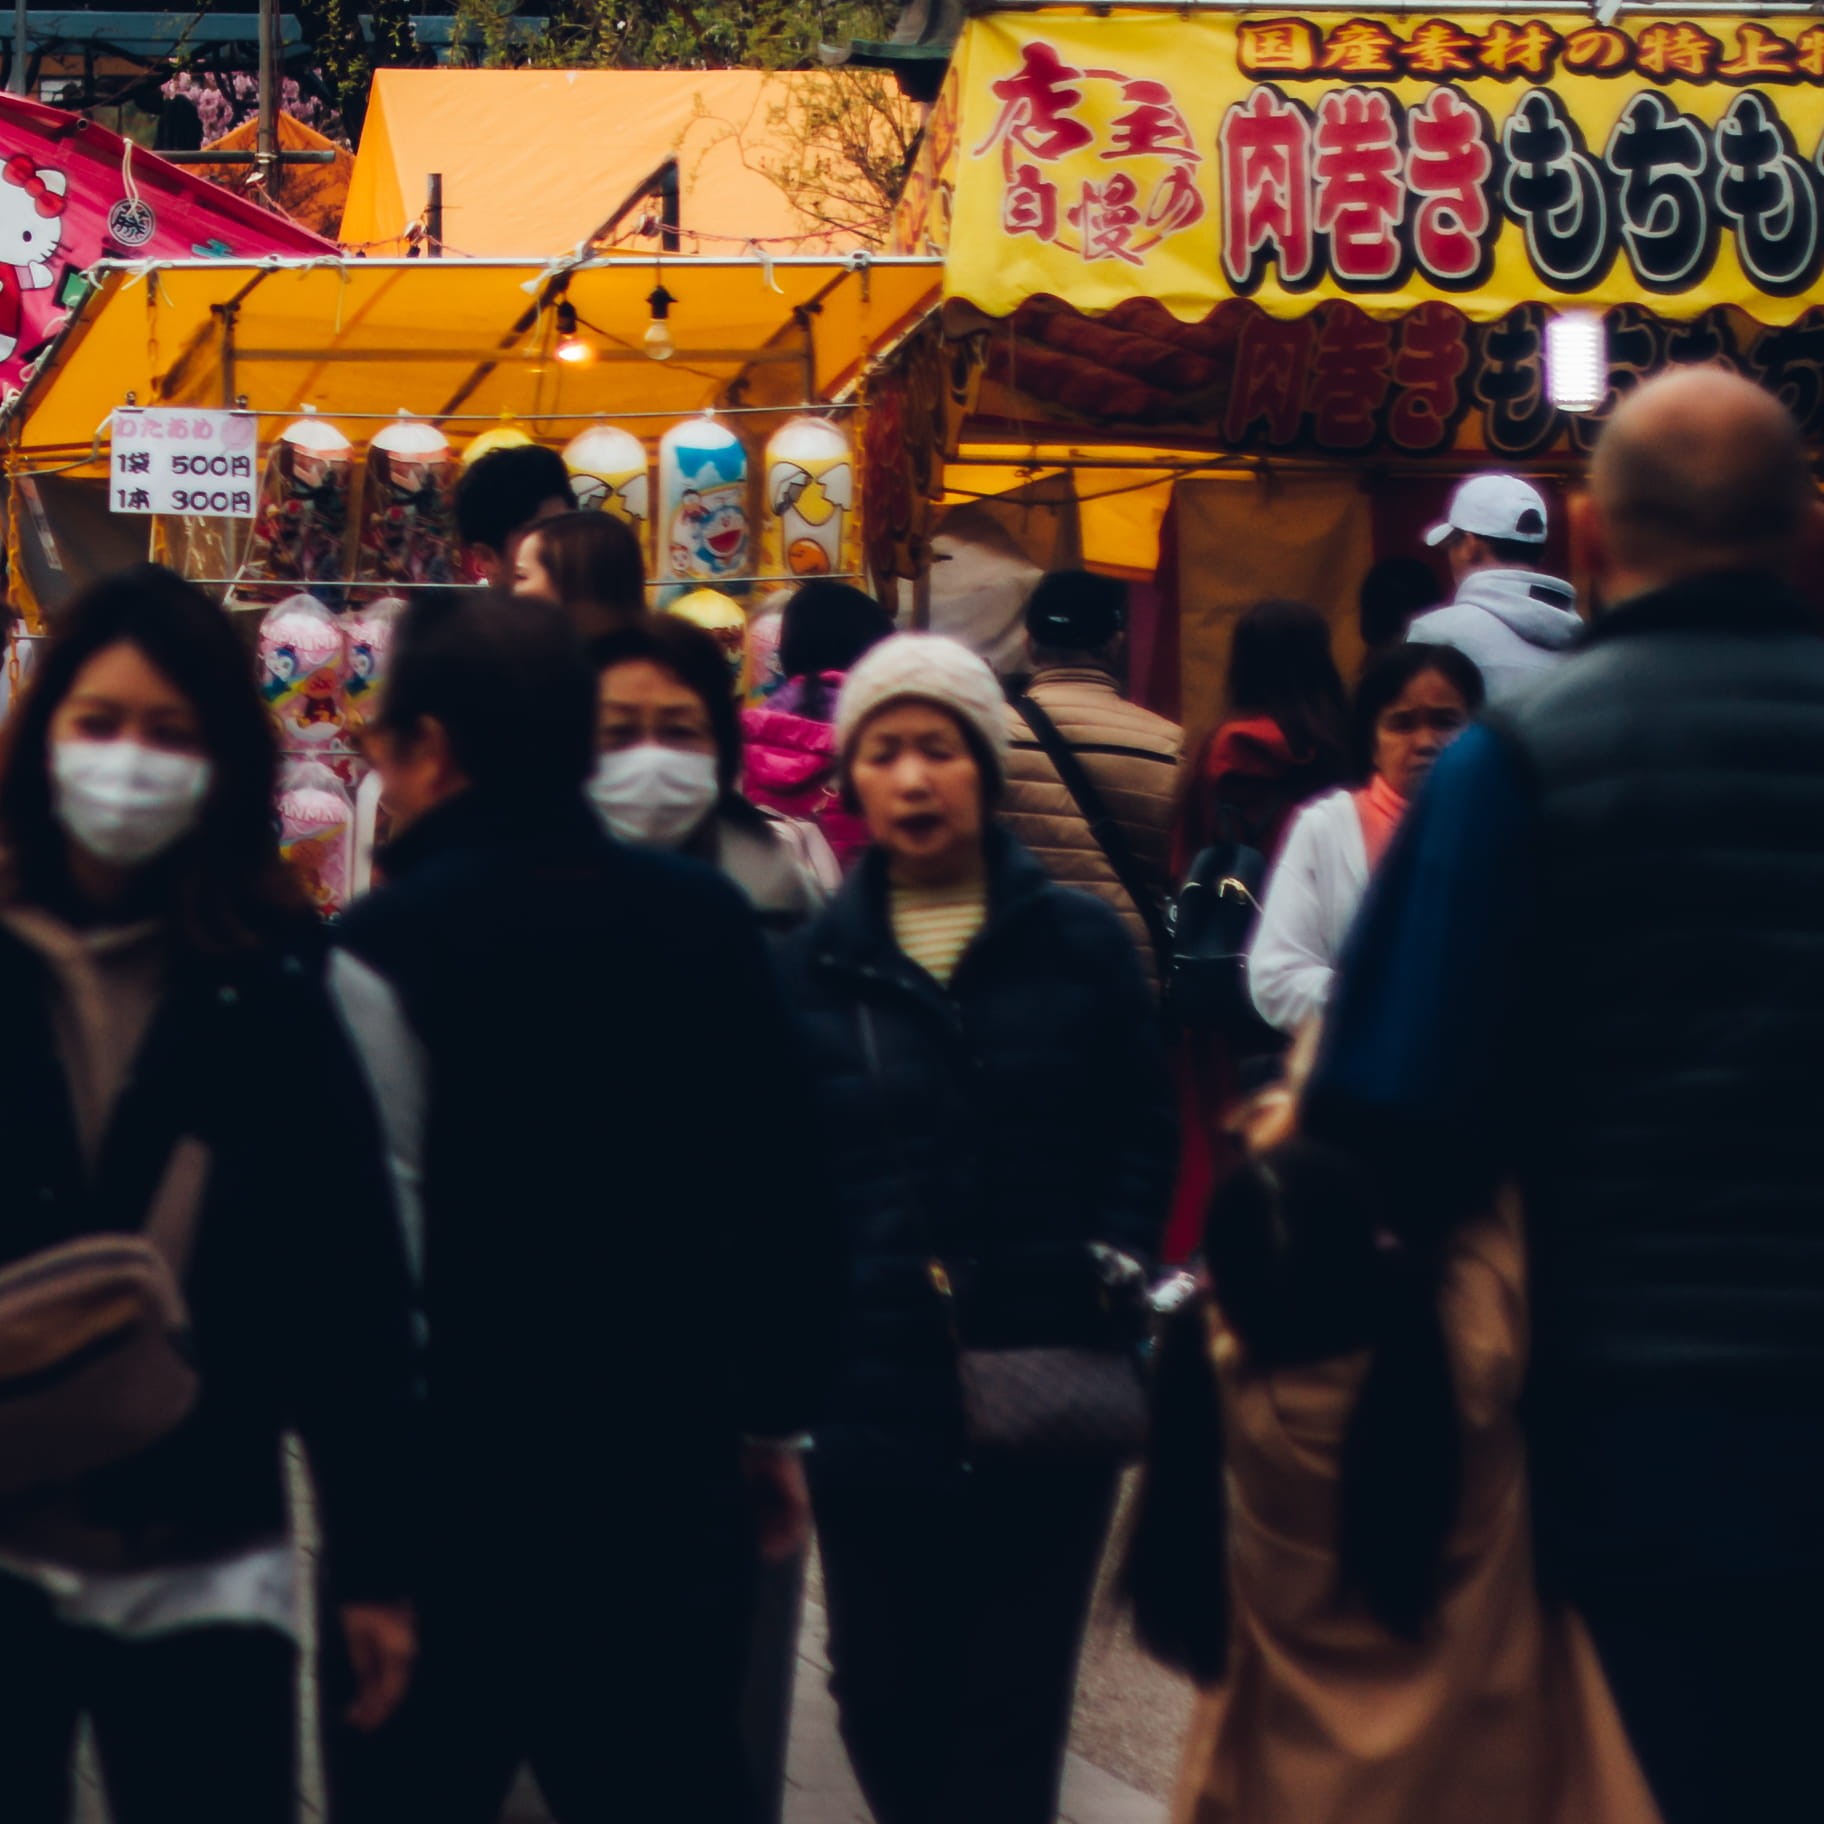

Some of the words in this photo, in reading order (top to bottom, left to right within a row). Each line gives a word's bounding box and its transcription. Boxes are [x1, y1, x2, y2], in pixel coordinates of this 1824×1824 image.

[972, 41, 1204, 161] 店主
[1003, 163, 1205, 266] 自慢の
[116, 417, 213, 439] わたあめ
[118, 452, 150, 474] 1袋
[171, 455, 251, 478] 500円
[117, 487, 150, 510] 1本
[171, 490, 251, 513] 300円
